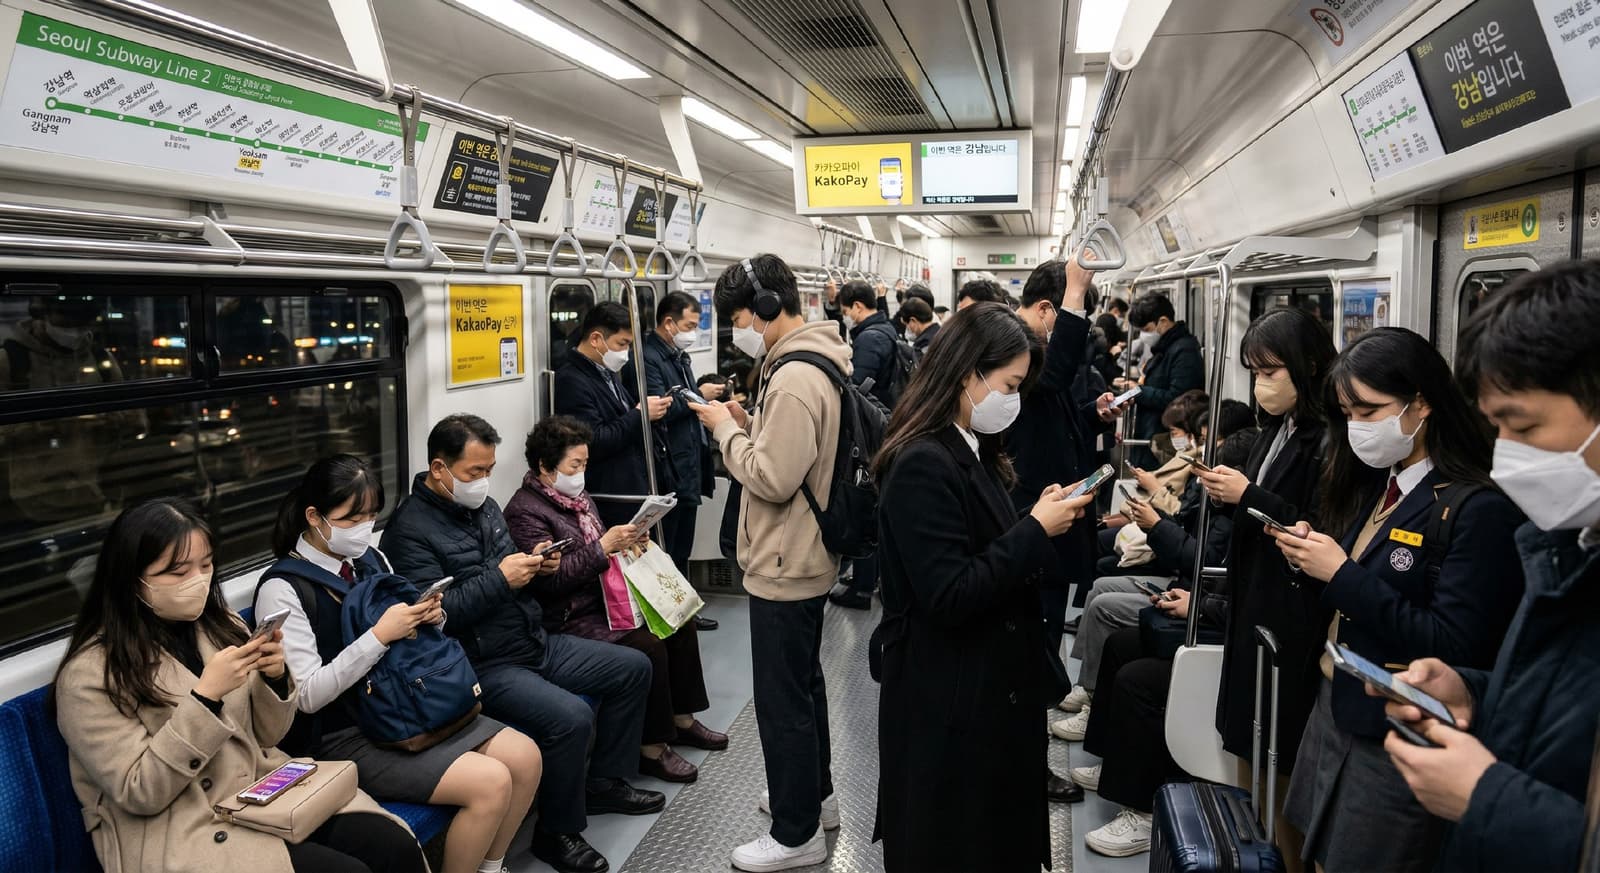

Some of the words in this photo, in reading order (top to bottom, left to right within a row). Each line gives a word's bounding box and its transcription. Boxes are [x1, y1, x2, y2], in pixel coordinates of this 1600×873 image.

[37, 25, 91, 53] Seoul
[96, 42, 161, 73] Subway
[167, 59, 198, 81] Line
[201, 69, 212, 85] 2
[1444, 40, 1474, 74] 이번
[1472, 21, 1506, 57] 역은
[43, 70, 75, 93] 강남역
[1452, 51, 1526, 110] 강남입니다
[22, 108, 72, 125] Gangnam
[31, 121, 60, 135] 강남역
[239, 147, 268, 160] Yeoksam
[458, 139, 475, 155] 이번
[476, 143, 491, 159] 역은
[930, 146, 946, 155] 이번
[947, 145, 962, 155] 역은
[965, 144, 1006, 155] 강남입니다
[814, 161, 860, 172] 카카오파이
[815, 175, 868, 188] KakoPay
[456, 298, 472, 314] 이번
[472, 298, 488, 313] 역은
[456, 316, 502, 334] KakaoPay
